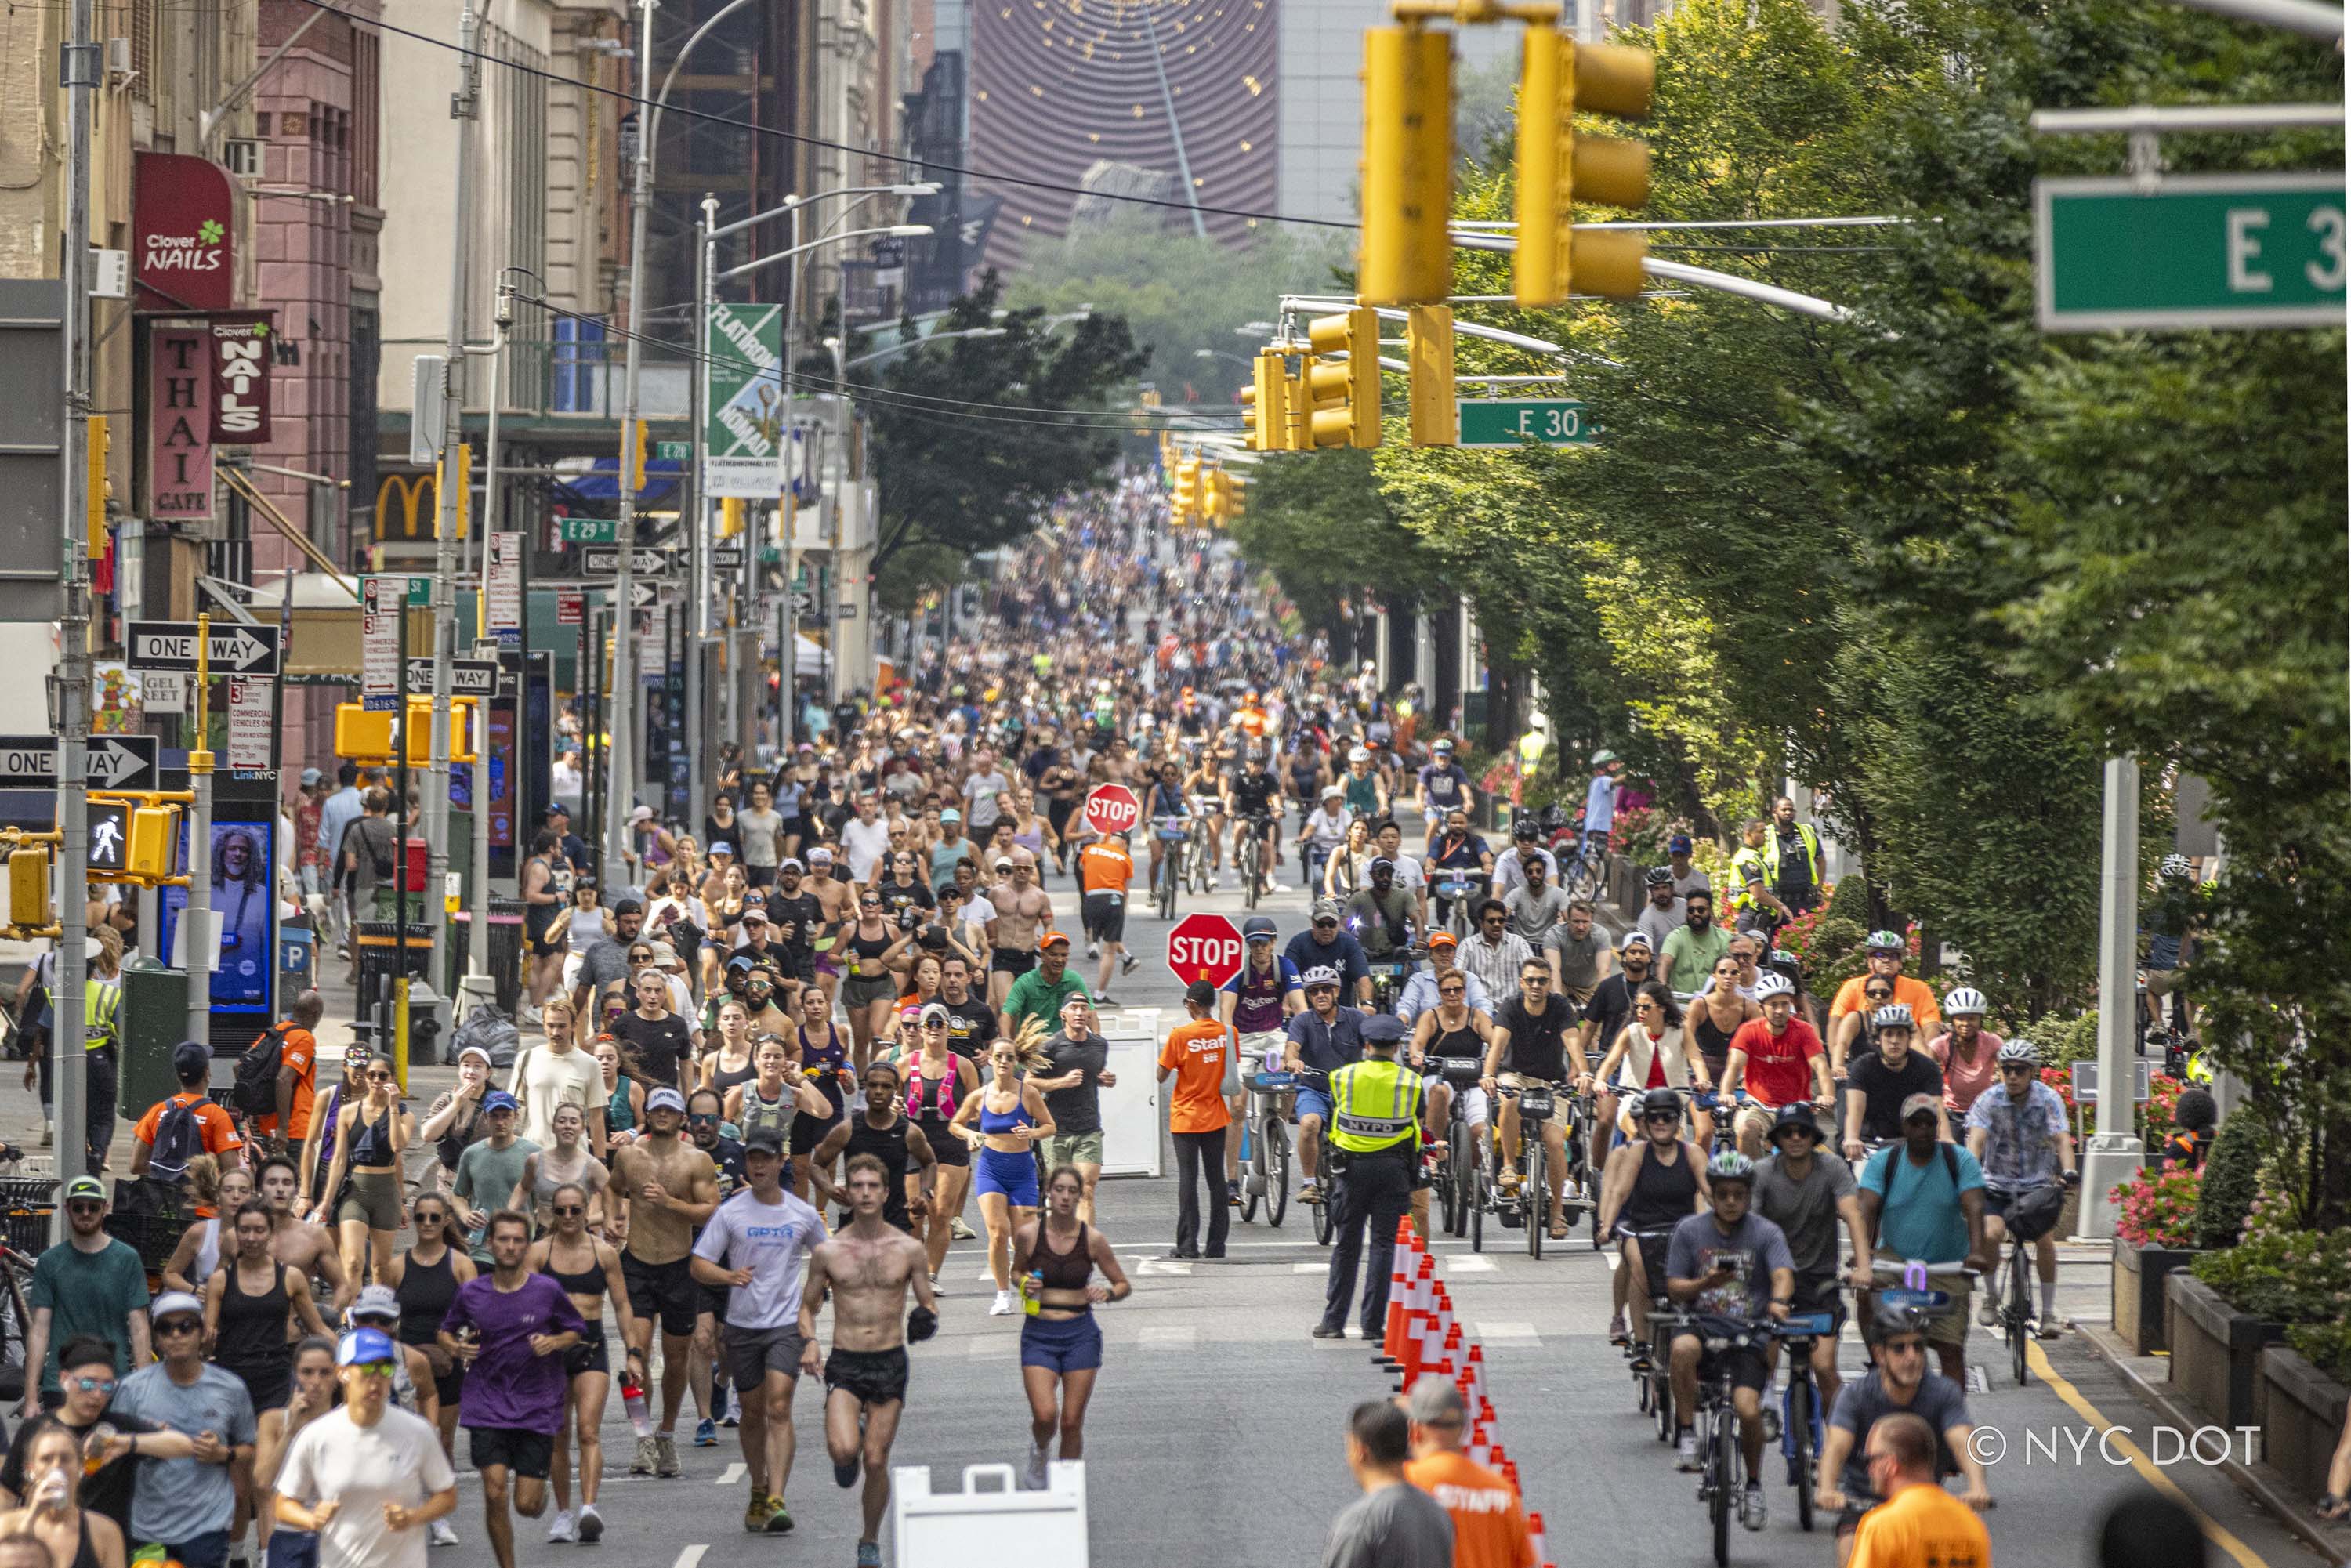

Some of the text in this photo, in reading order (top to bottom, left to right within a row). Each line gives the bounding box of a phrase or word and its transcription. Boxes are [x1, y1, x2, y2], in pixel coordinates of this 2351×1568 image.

[147, 234, 196, 248] Clover
[2226, 206, 2273, 294] E
[144, 249, 223, 271] NAILS
[213, 327, 252, 337] Clover
[710, 304, 776, 367] FLATIRON
[220, 340, 263, 431] NAILS
[163, 339, 201, 484] THAI
[1519, 410, 1534, 435] E
[1545, 409, 1578, 436] 30
[157, 492, 207, 511] CAFE
[568, 523, 577, 538] E
[580, 523, 597, 538] 29
[633, 556, 656, 567] AY
[150, 638, 255, 659] ONE WAY
[455, 672, 486, 685] WAY
[232, 685, 241, 703] 3
[9, 752, 53, 773] ONE
[233, 771, 277, 780] LinkNYC
[1088, 797, 1136, 823] STOP
[288, 945, 304, 969] P
[1172, 936, 1241, 966] STOP
[1348, 1121, 1393, 1132] NYPD
